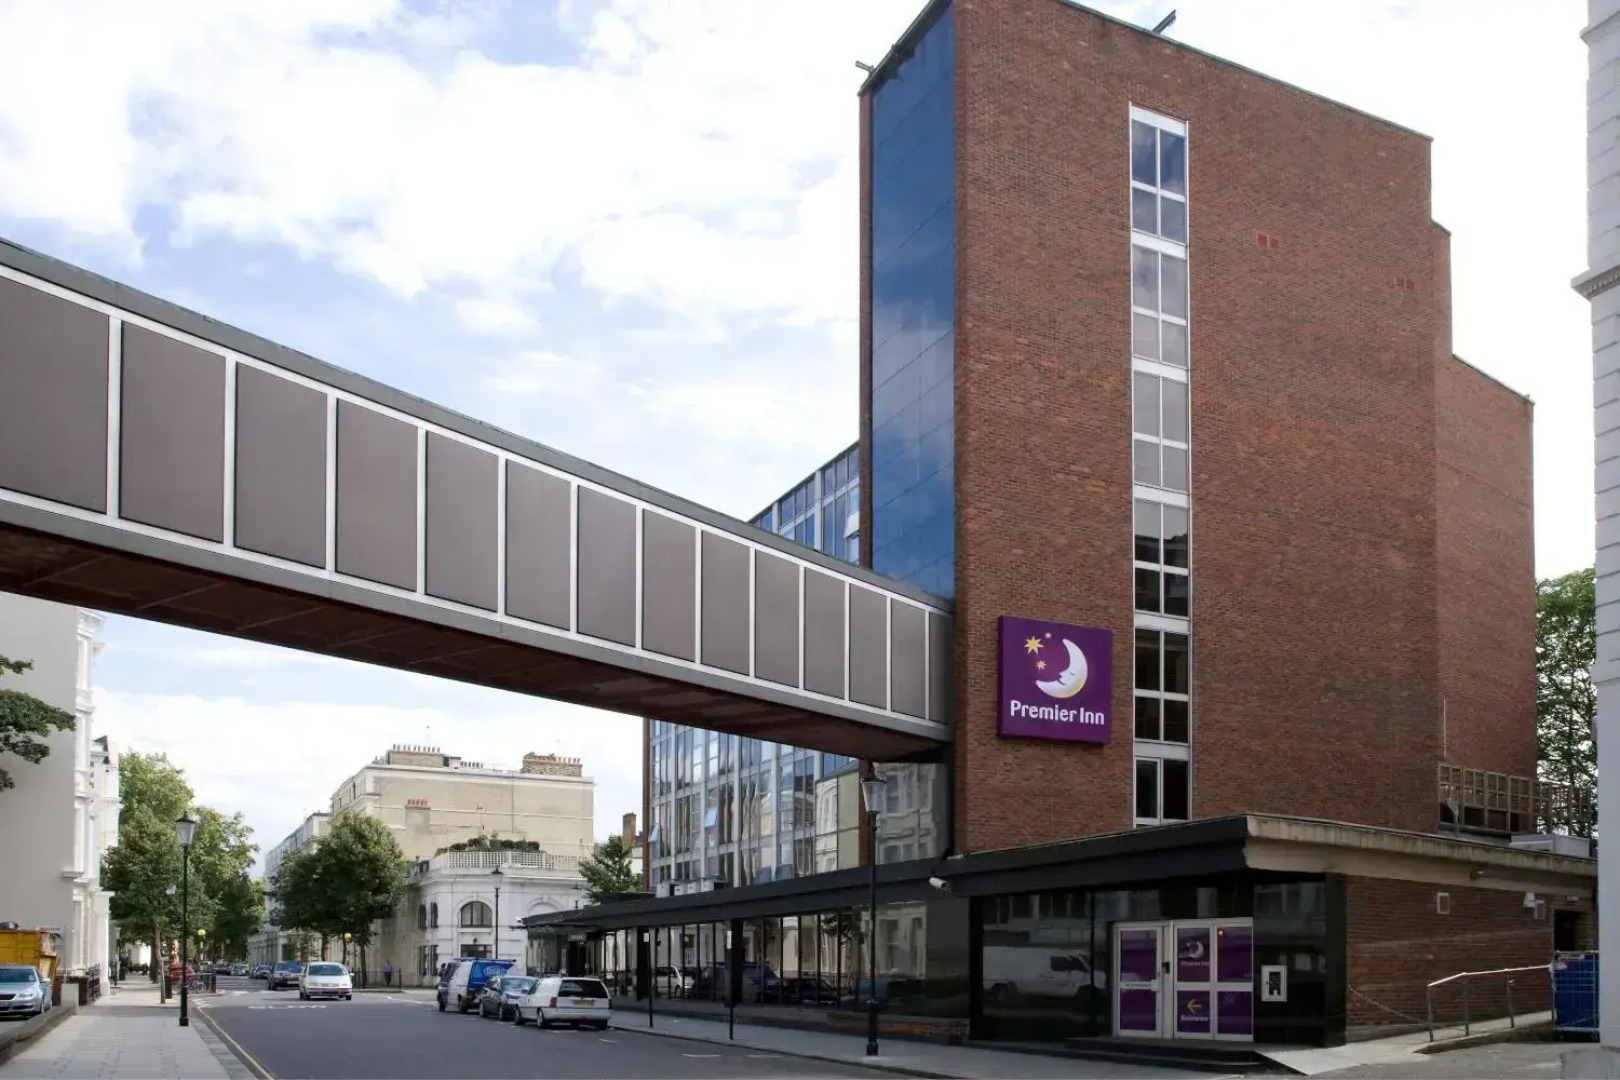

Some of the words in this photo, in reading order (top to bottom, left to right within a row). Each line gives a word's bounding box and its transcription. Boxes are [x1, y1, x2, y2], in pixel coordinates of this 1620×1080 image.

[1010, 699, 1077, 722] Premier
[1080, 707, 1105, 725] Inn
[1181, 1014, 1209, 1022] Entrance
